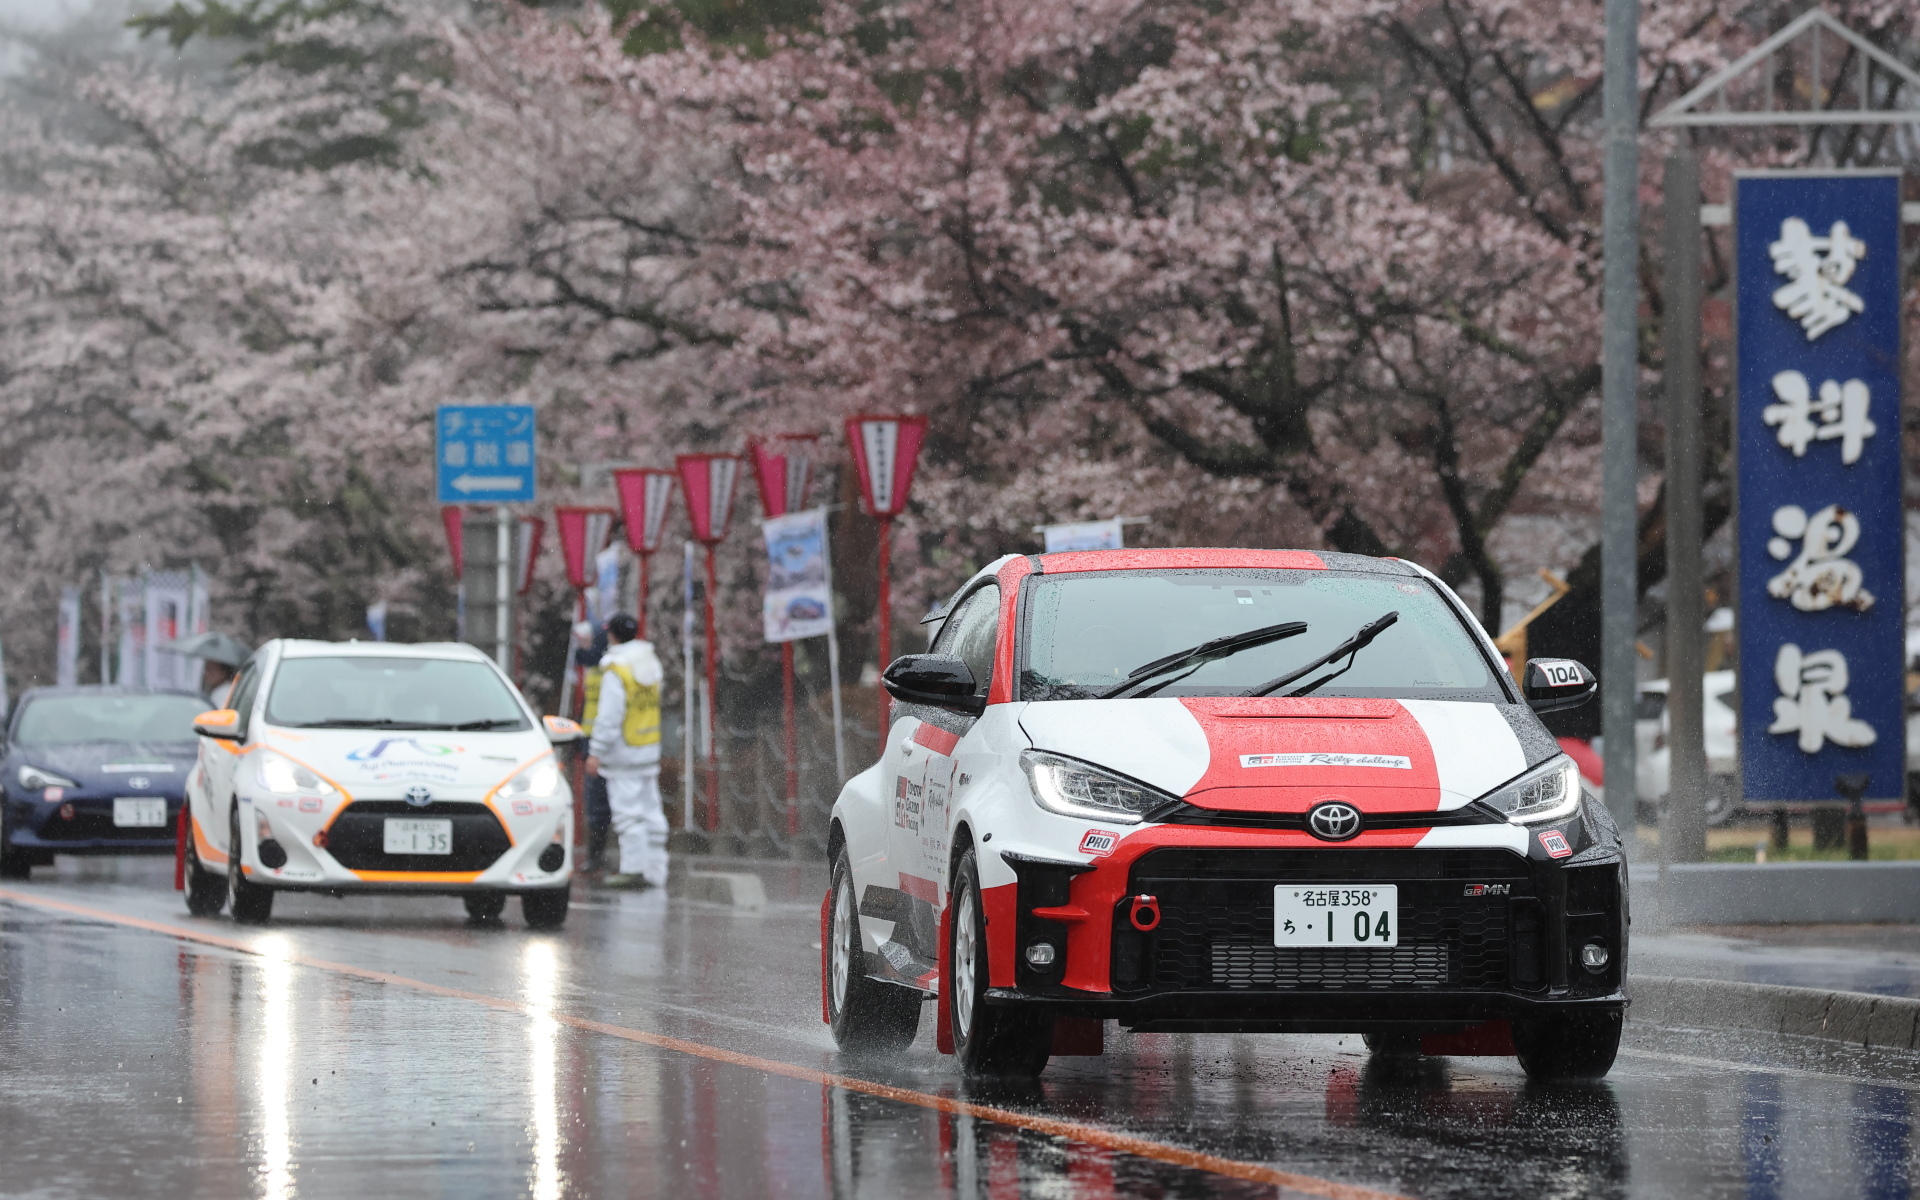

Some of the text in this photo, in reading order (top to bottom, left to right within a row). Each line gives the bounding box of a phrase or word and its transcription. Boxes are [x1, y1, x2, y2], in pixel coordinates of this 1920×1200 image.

[1763, 216, 1876, 755] 蓼科温泉
[1547, 666, 1579, 684] 104
[1309, 753, 1405, 766] Rally challenge
[1086, 835, 1111, 850] PRO
[1546, 837, 1565, 851] PRO
